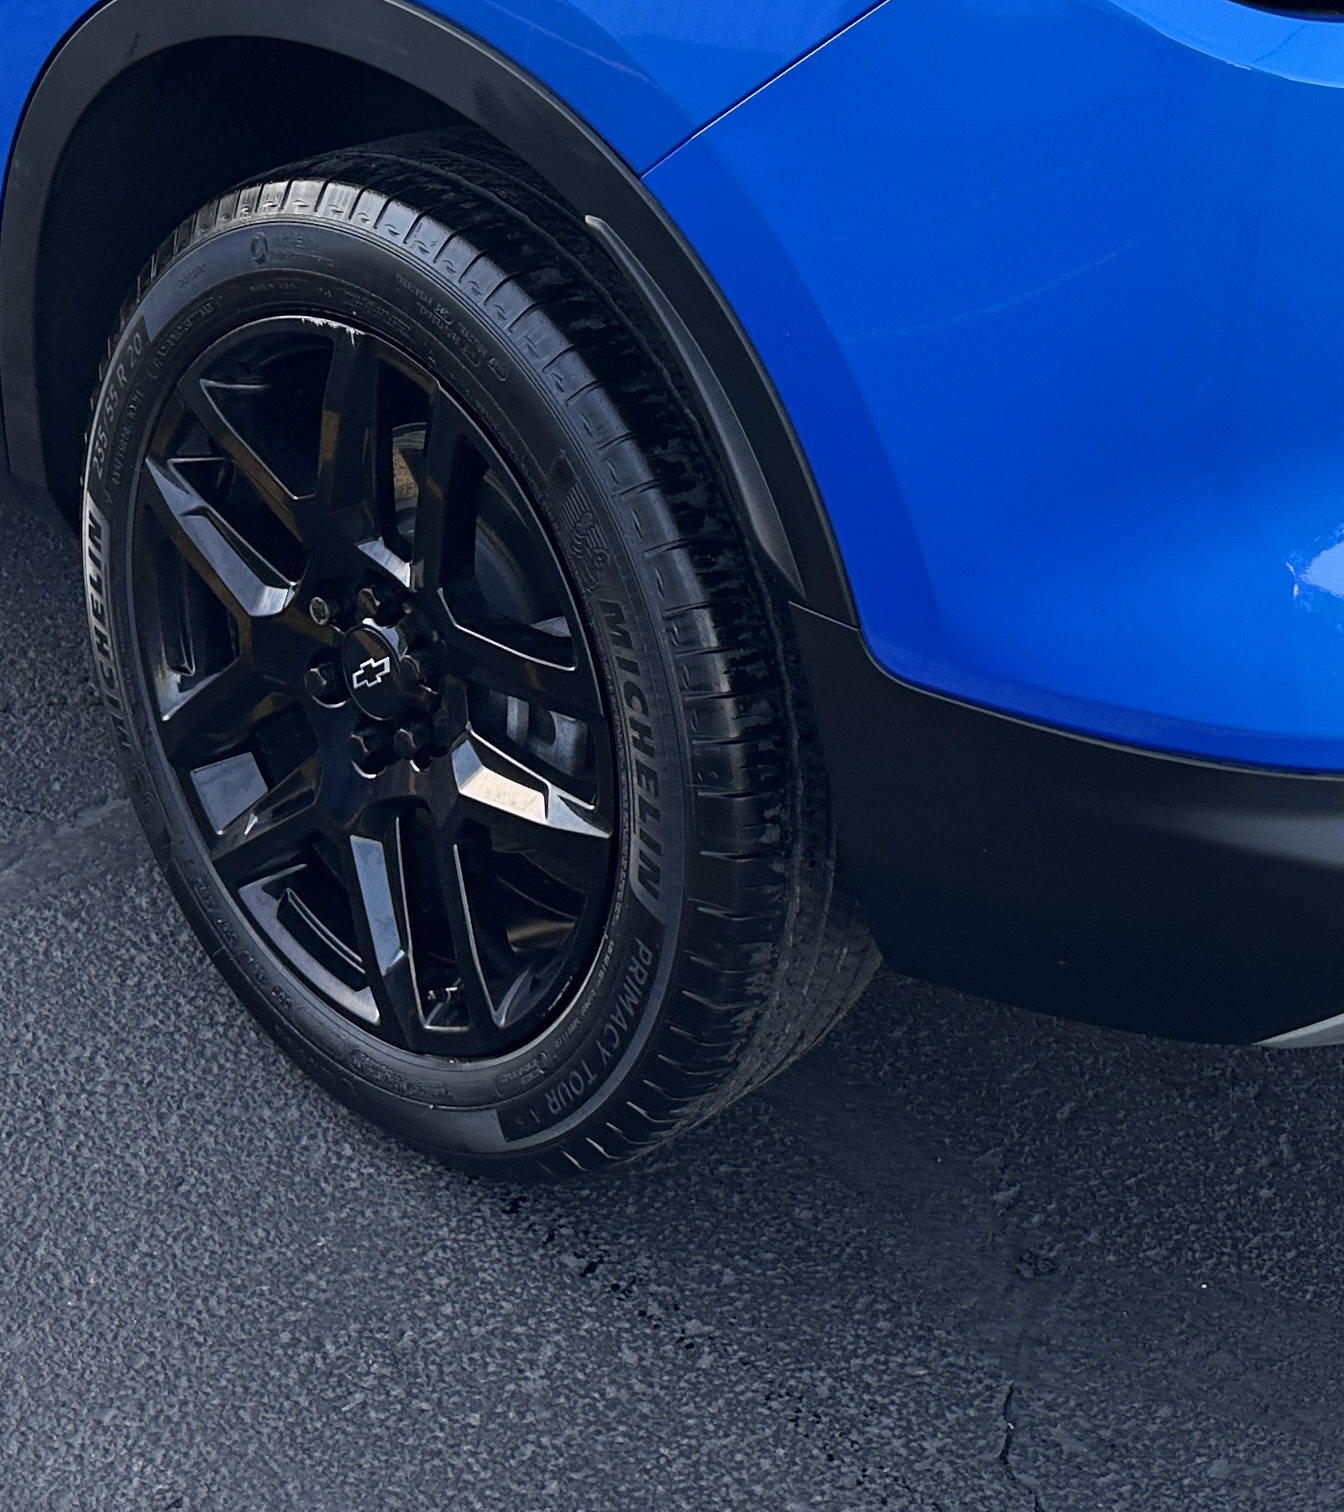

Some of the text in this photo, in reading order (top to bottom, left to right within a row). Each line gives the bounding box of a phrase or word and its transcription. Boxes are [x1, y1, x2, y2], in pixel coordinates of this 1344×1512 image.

[599, 598, 660, 900] MICHELIN
[586, 938, 653, 1067] PRIMACY
[544, 1059, 598, 1114] TOUR
